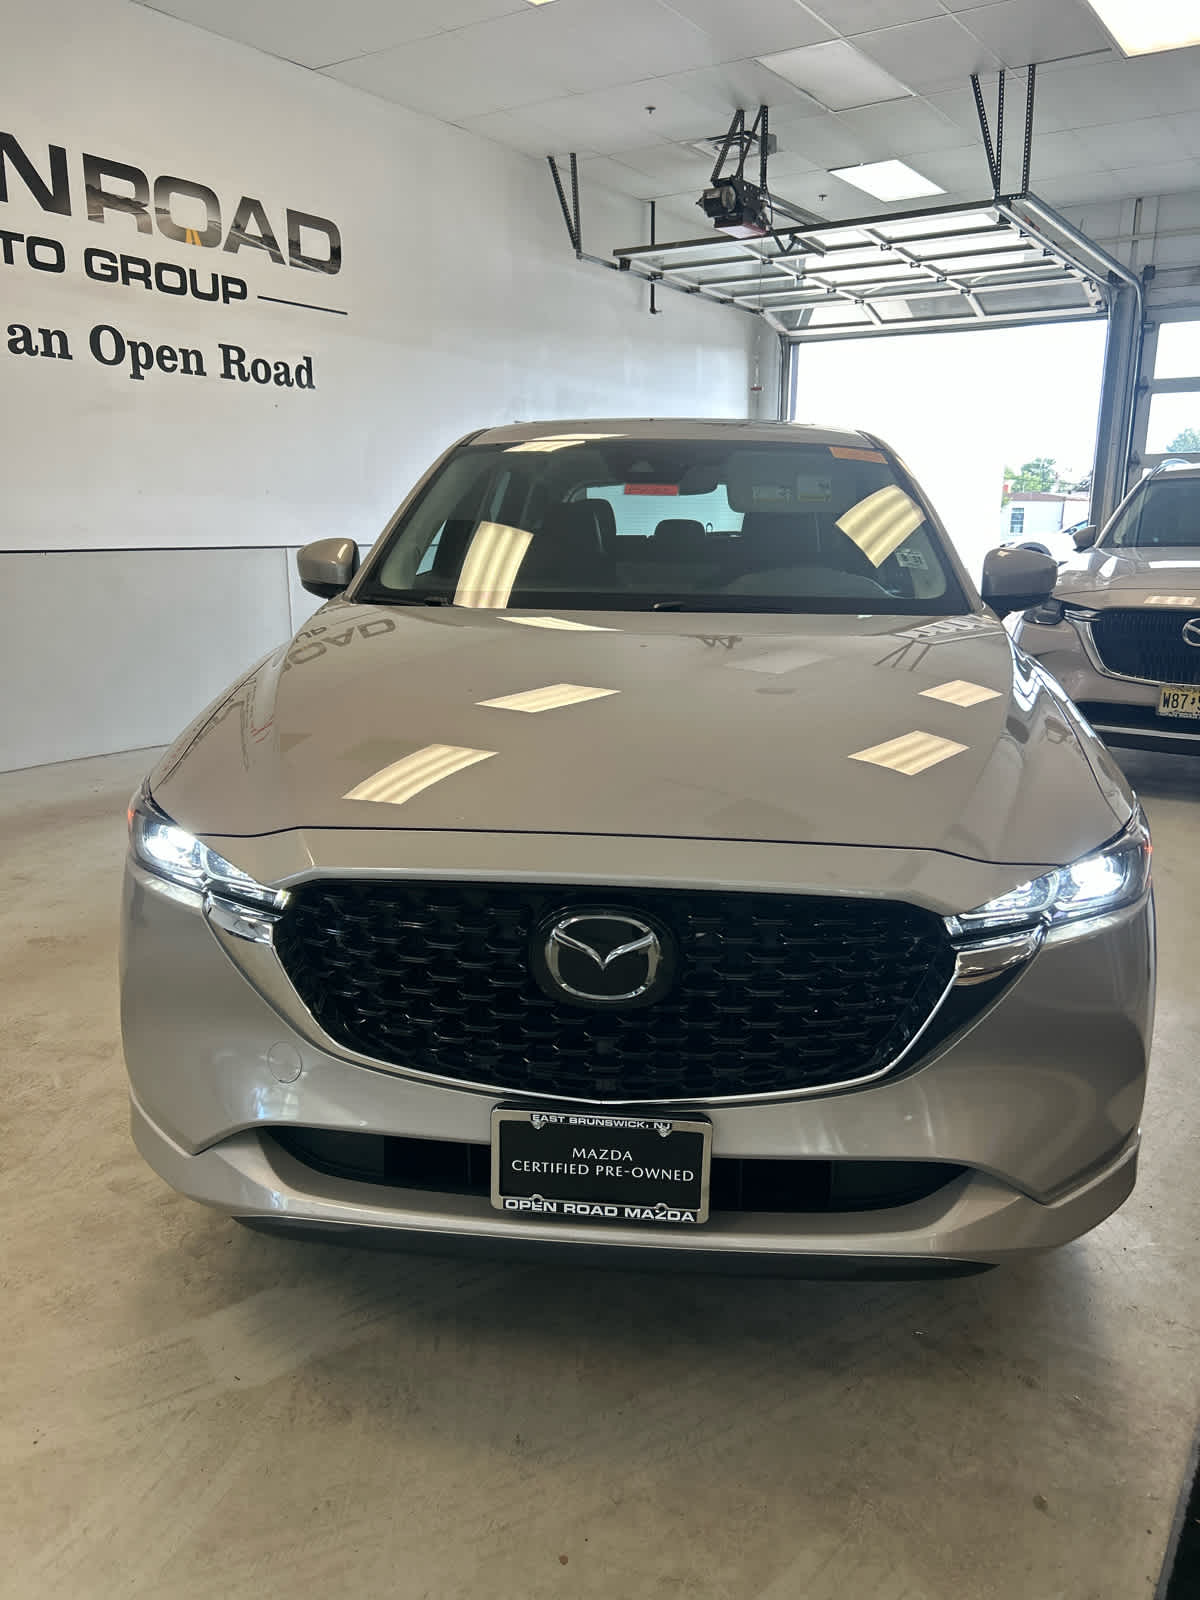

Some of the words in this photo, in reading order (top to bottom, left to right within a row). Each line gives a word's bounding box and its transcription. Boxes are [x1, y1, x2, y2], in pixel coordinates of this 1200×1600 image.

[83, 247, 248, 304] GROUP
[7, 323, 73, 360] an
[88, 324, 207, 381] Open
[217, 343, 316, 389] Road
[532, 1113, 566, 1124] EAST
[569, 1116, 650, 1129] BRUNSWICK,
[653, 1121, 673, 1131] NJ
[572, 1147, 633, 1161] MAZDA
[511, 1159, 589, 1175] CERTIFIED
[595, 1165, 695, 1182] PRE-OWNED
[505, 1199, 557, 1213] OPEN
[563, 1203, 618, 1217] ROAD
[624, 1208, 695, 1222] MAZDA
